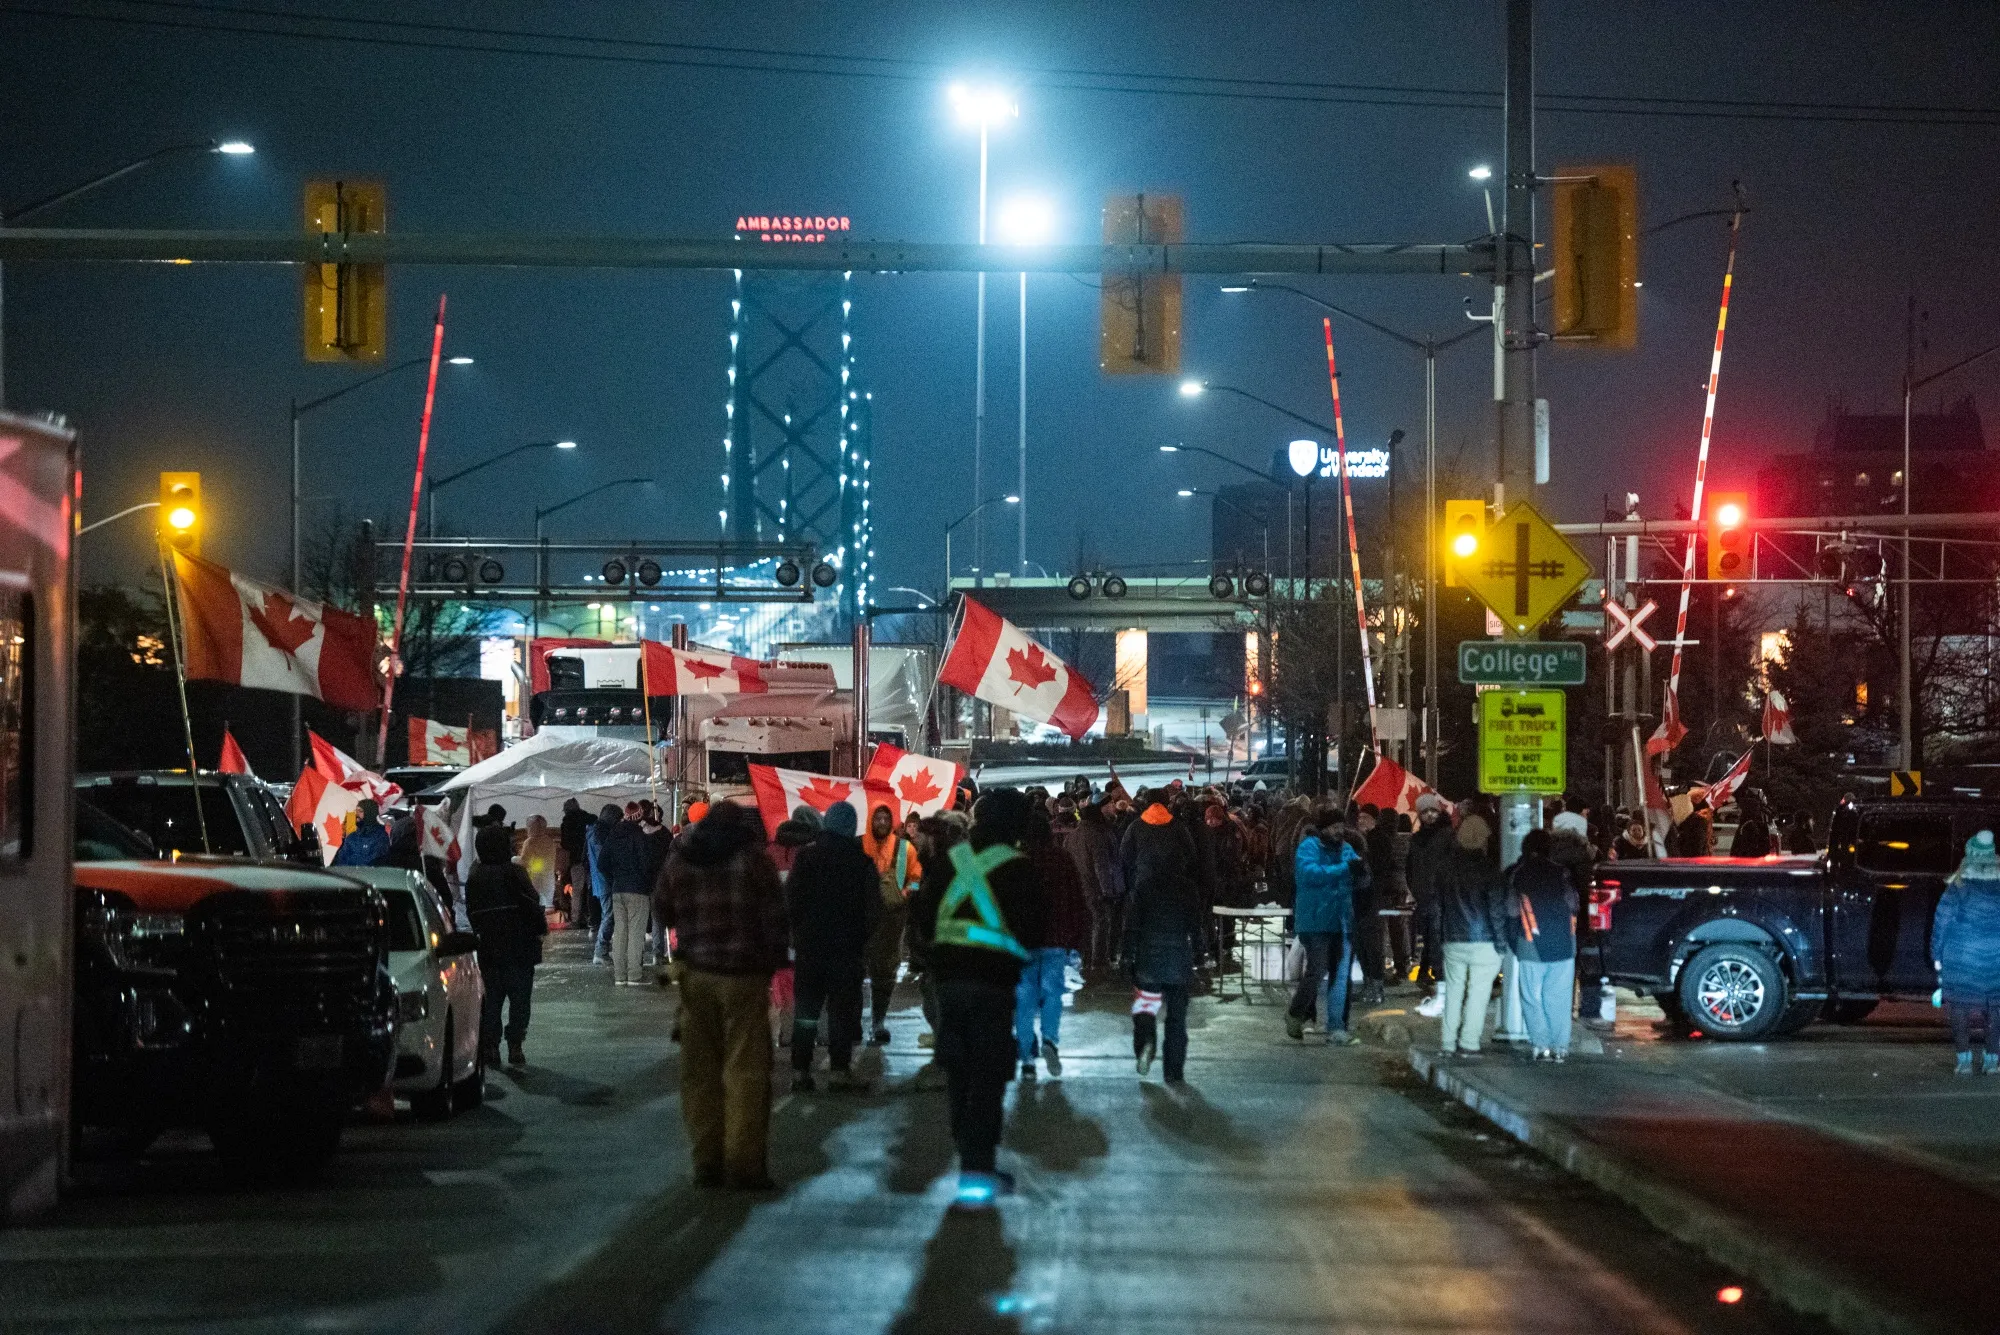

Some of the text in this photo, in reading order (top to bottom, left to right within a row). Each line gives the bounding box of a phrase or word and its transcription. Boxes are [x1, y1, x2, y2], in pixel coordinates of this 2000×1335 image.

[736, 216, 850, 231] AMBASSADOR
[1320, 447, 1390, 468] Unversity
[1331, 463, 1390, 477] Wndsor
[1489, 620, 1503, 628] SIG
[1464, 648, 1558, 680] College
[1488, 720, 1557, 732] FIRE TRUCK
[1504, 734, 1542, 747] ROUTE
[1504, 753, 1541, 763] DO NOT
[1507, 764, 1539, 774] BLOCK
[1488, 776, 1558, 786] INTERSECTION
